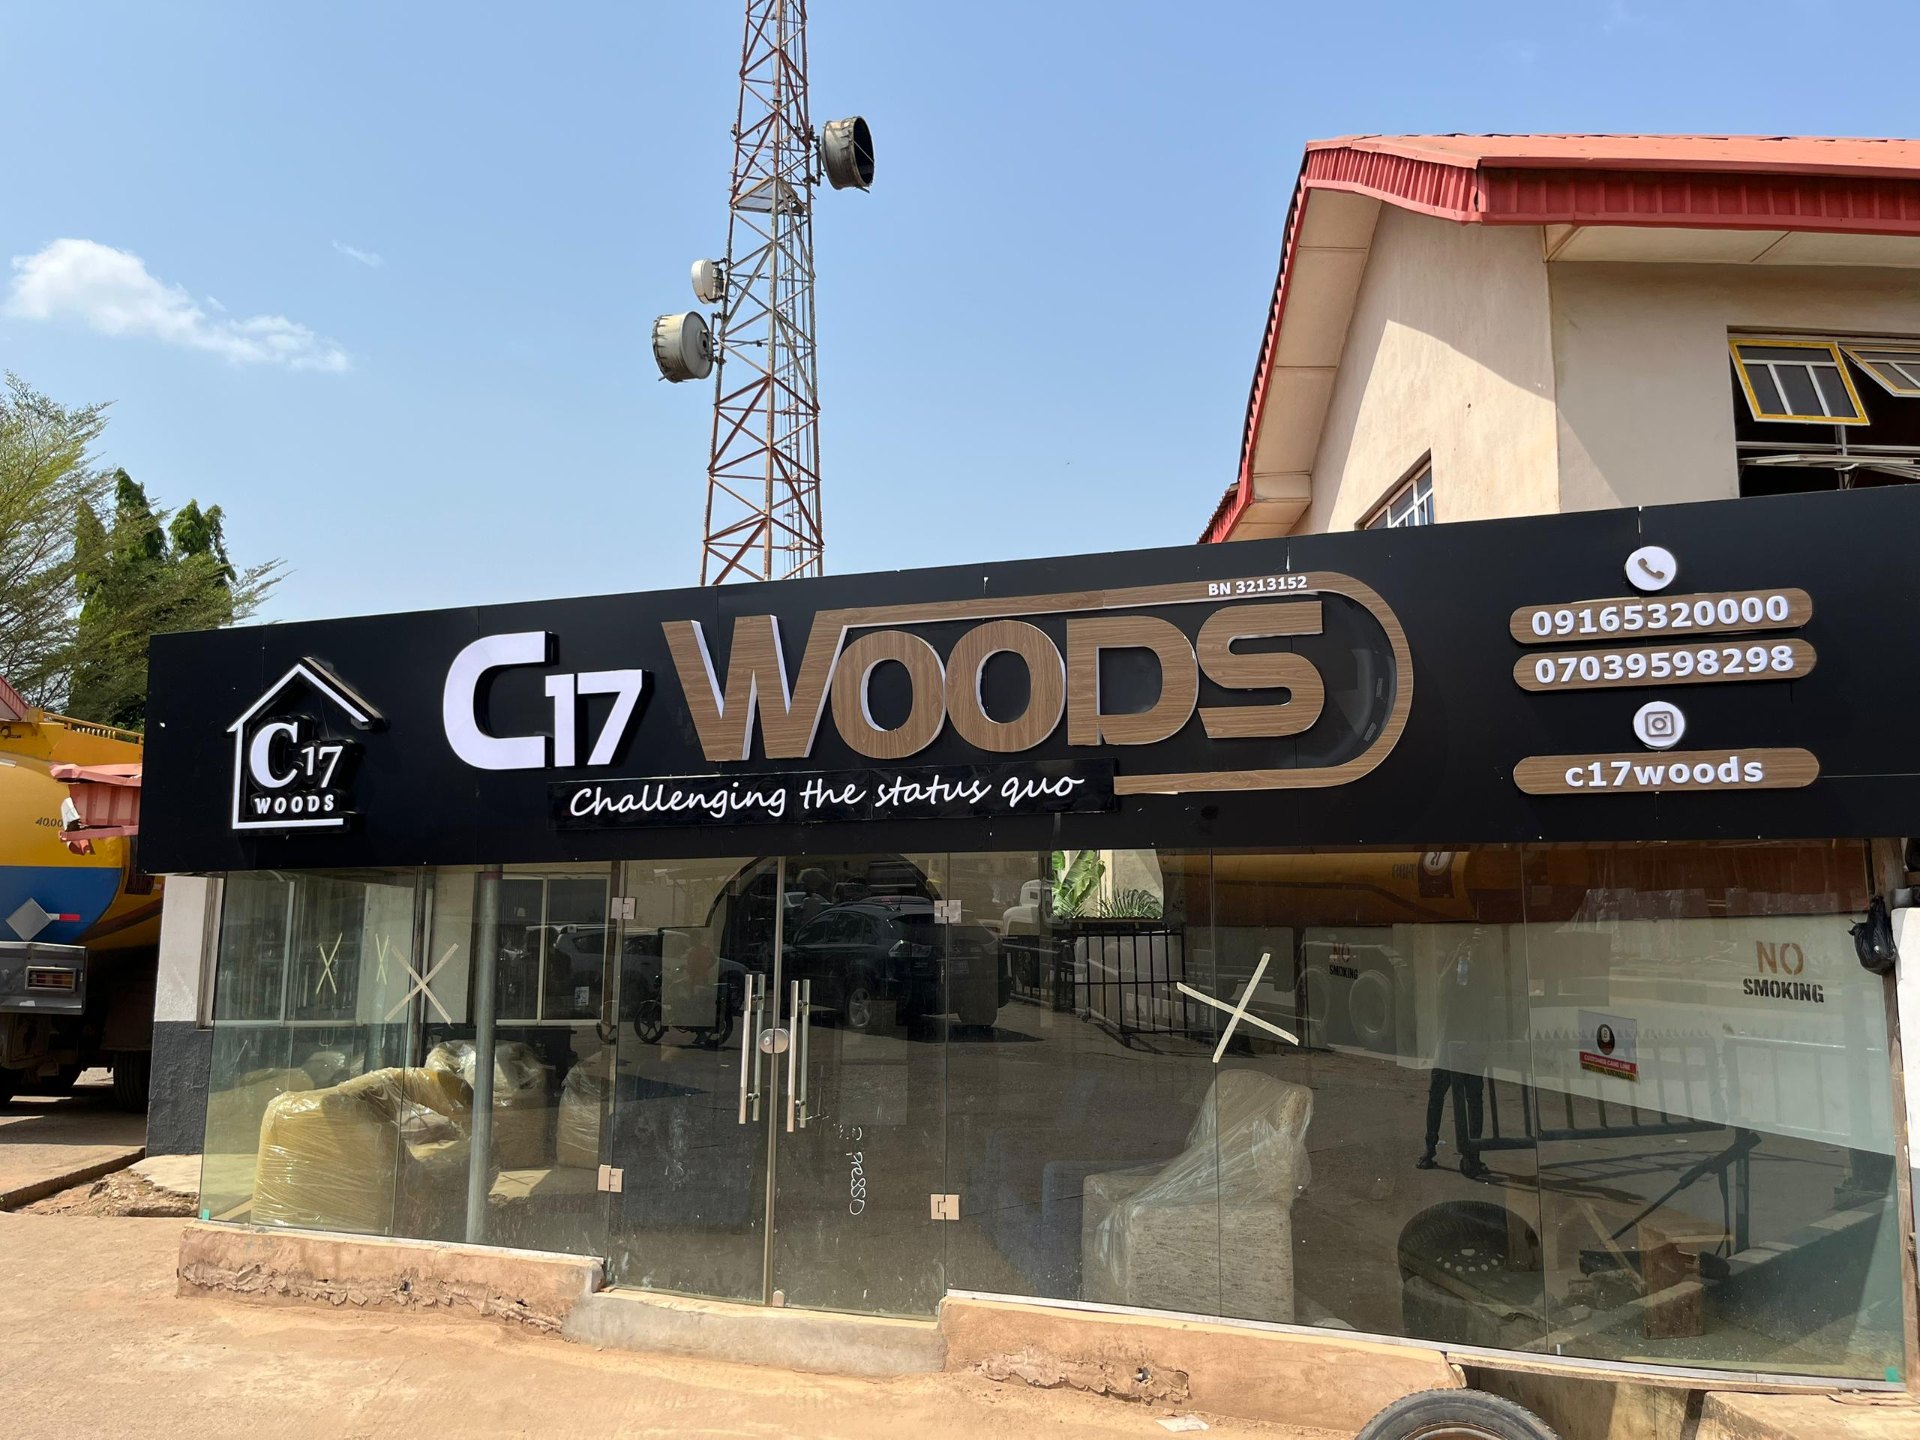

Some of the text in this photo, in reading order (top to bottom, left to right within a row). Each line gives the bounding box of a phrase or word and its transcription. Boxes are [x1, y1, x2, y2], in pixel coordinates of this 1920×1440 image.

[1208, 575, 1308, 596] BN 3213152
[1531, 595, 1789, 636] 09165320000
[1534, 645, 1795, 684] 07039598298
[443, 600, 1325, 771] C17 WOODS
[250, 721, 343, 788] C17
[1564, 756, 1764, 787] c17woods
[254, 794, 335, 814] WOODS
[570, 774, 1085, 818] Challenging the status quo
[1329, 964, 1359, 980] SMOKING
[1756, 940, 1804, 976] NO
[1743, 978, 1824, 1003] SMOKING
